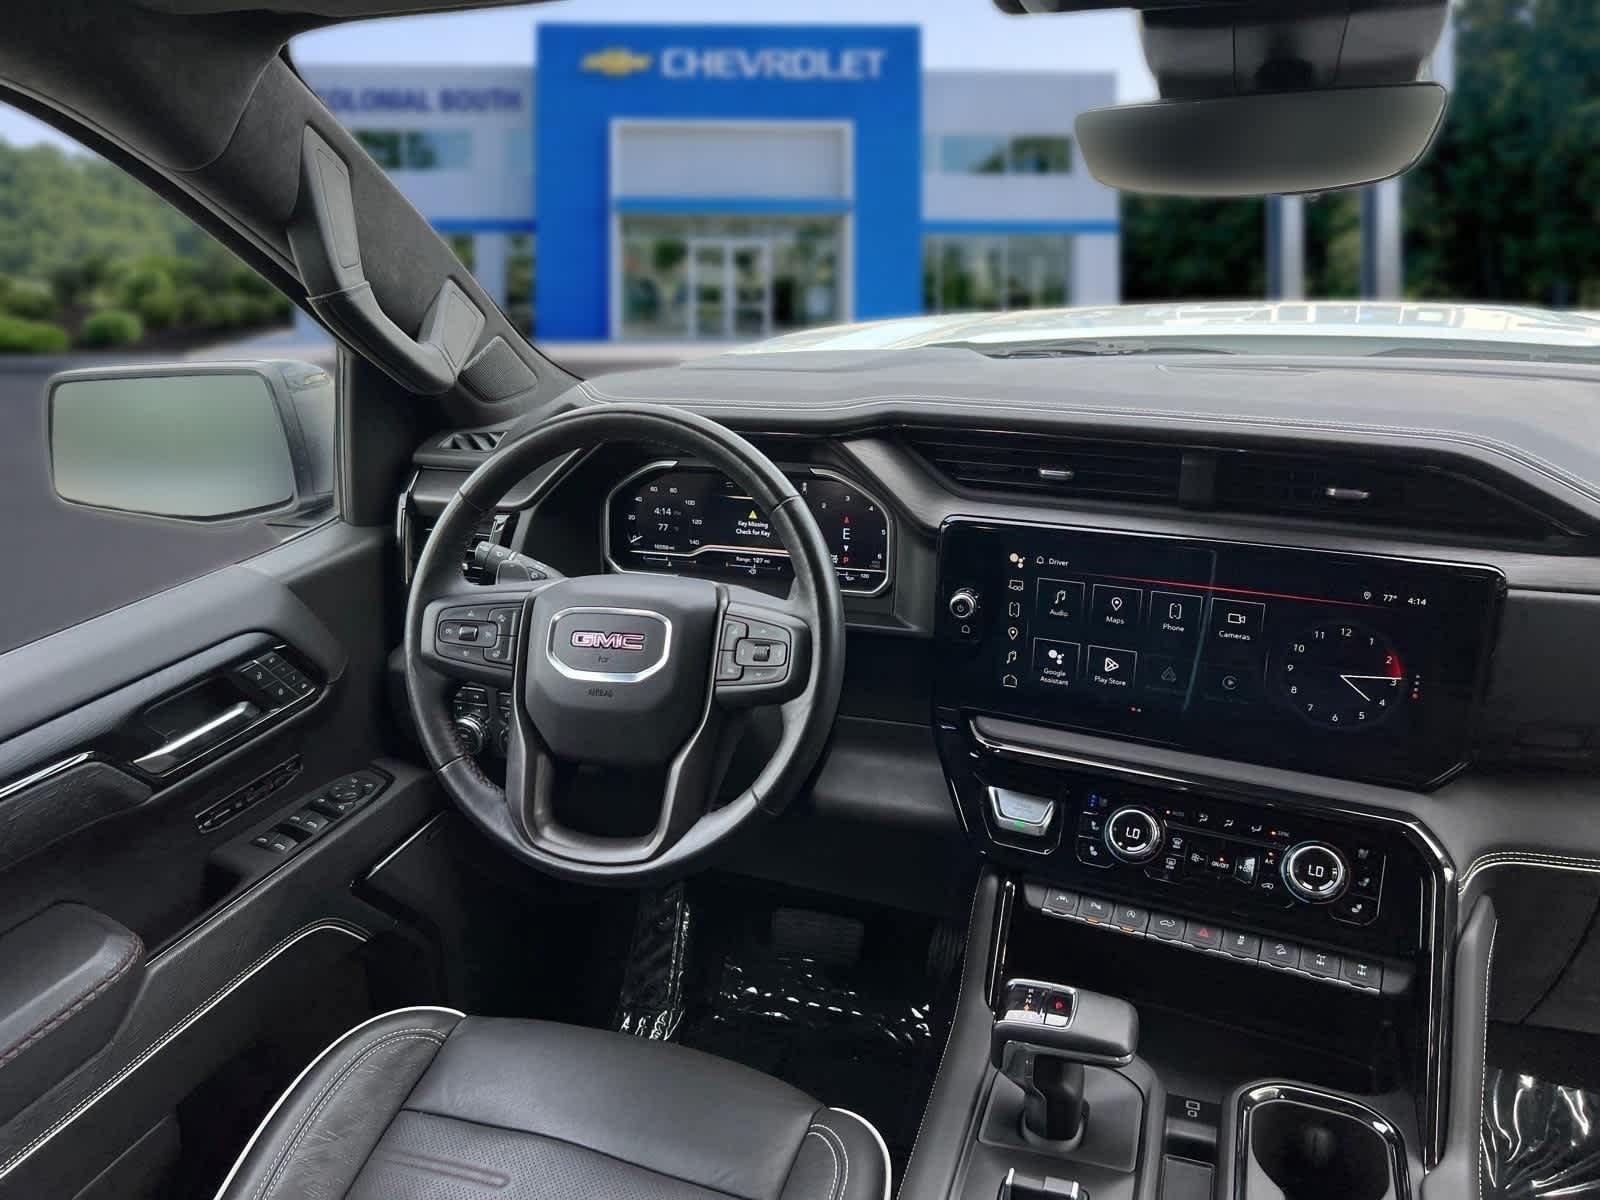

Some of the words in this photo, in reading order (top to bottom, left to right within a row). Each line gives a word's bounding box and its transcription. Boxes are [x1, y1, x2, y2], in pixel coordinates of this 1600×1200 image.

[660, 48, 887, 80] CHEVROLET
[439, 87, 522, 113] SOUTH
[654, 507, 672, 516] 4:14
[658, 523, 669, 532] 77
[738, 520, 747, 528] Key
[748, 521, 769, 529] Missing
[843, 528, 850, 540] E
[1048, 557, 1069, 567] Driver
[1407, 597, 1427, 606] 4:14
[1049, 609, 1069, 617] Audio
[1105, 616, 1125, 625] Maps
[1162, 623, 1185, 632] Phone
[1340, 627, 1352, 637] 12
[1218, 630, 1251, 641] Cameras
[1314, 630, 1325, 639] 11
[571, 631, 644, 650] GMC
[1369, 637, 1374, 646] 1
[1293, 643, 1305, 653] 10
[1385, 655, 1393, 664] 2
[1043, 668, 1067, 677] Google
[1287, 664, 1294, 672] 9
[1040, 676, 1069, 686] Assistant
[1094, 675, 1108, 686] Play
[1109, 677, 1126, 687] Store
[1390, 679, 1397, 687] 3
[1291, 686, 1297, 694] 8
[1332, 714, 1339, 722] 6
[1358, 712, 1365, 720] 5
